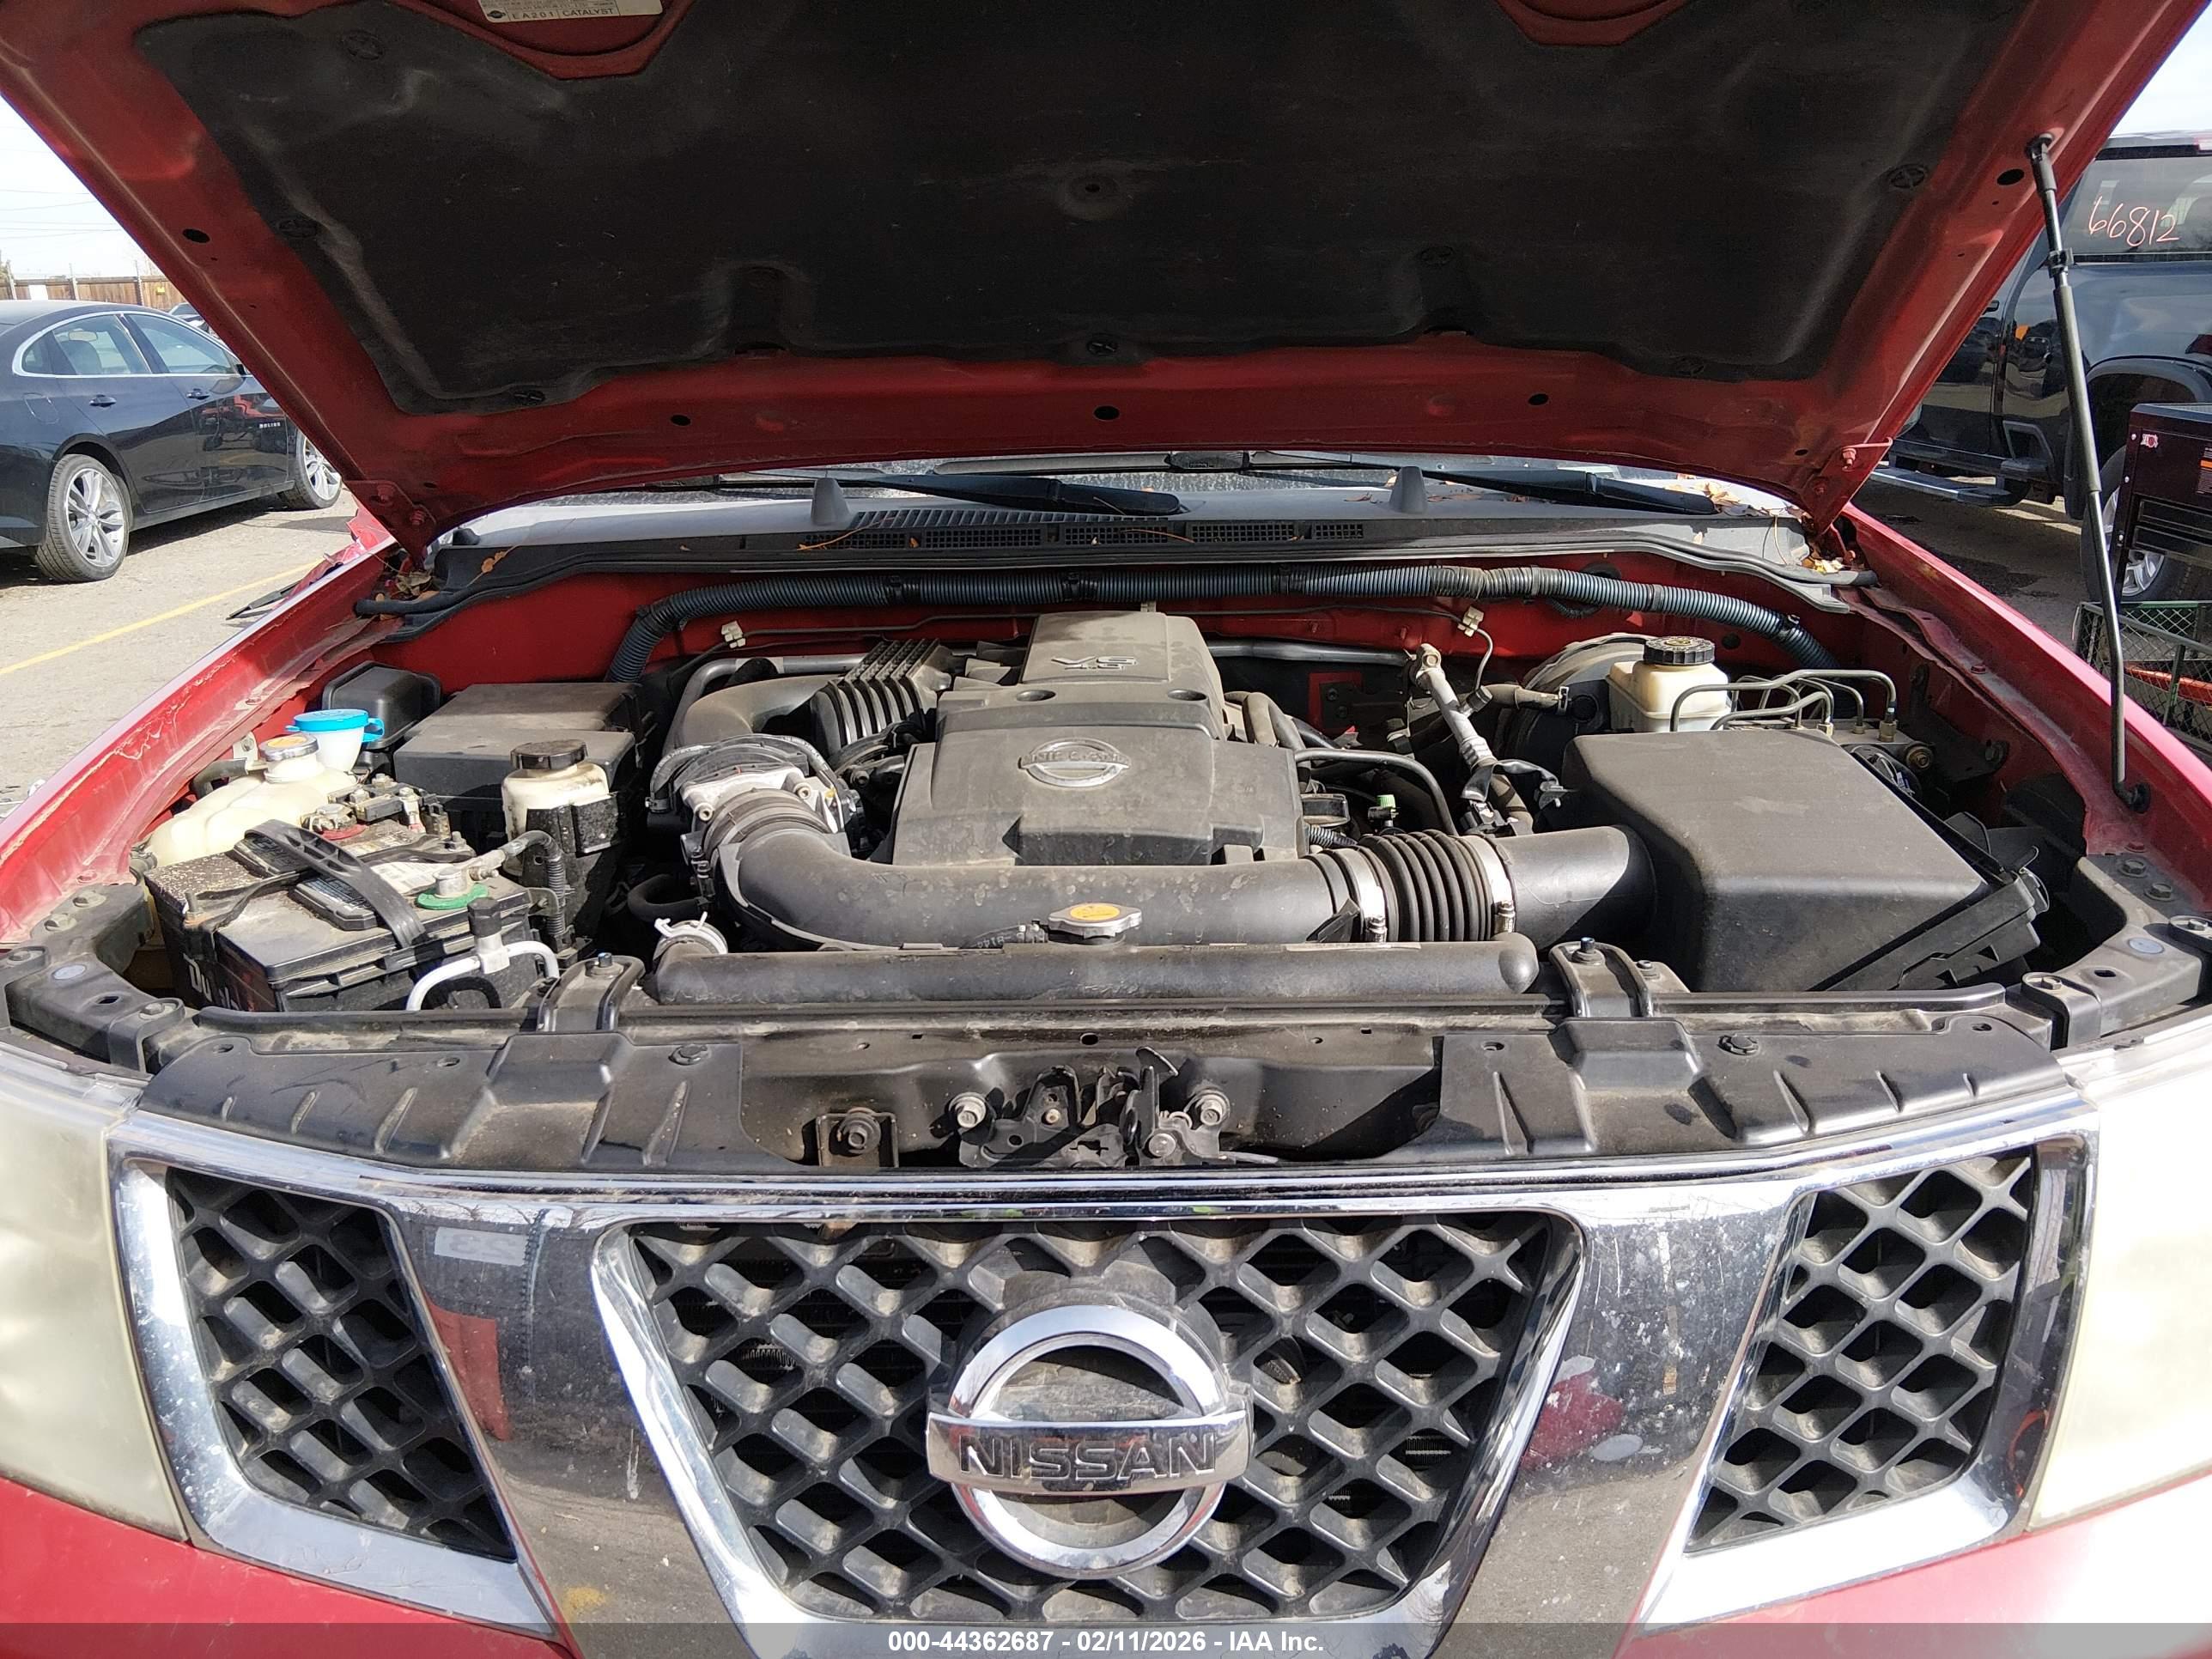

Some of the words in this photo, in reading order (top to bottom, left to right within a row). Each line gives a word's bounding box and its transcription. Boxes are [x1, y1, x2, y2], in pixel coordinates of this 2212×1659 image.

[562, 8, 613, 17] CATALYST
[2088, 196, 2179, 246] 66812
[959, 1433, 1216, 1481] NISSAN
